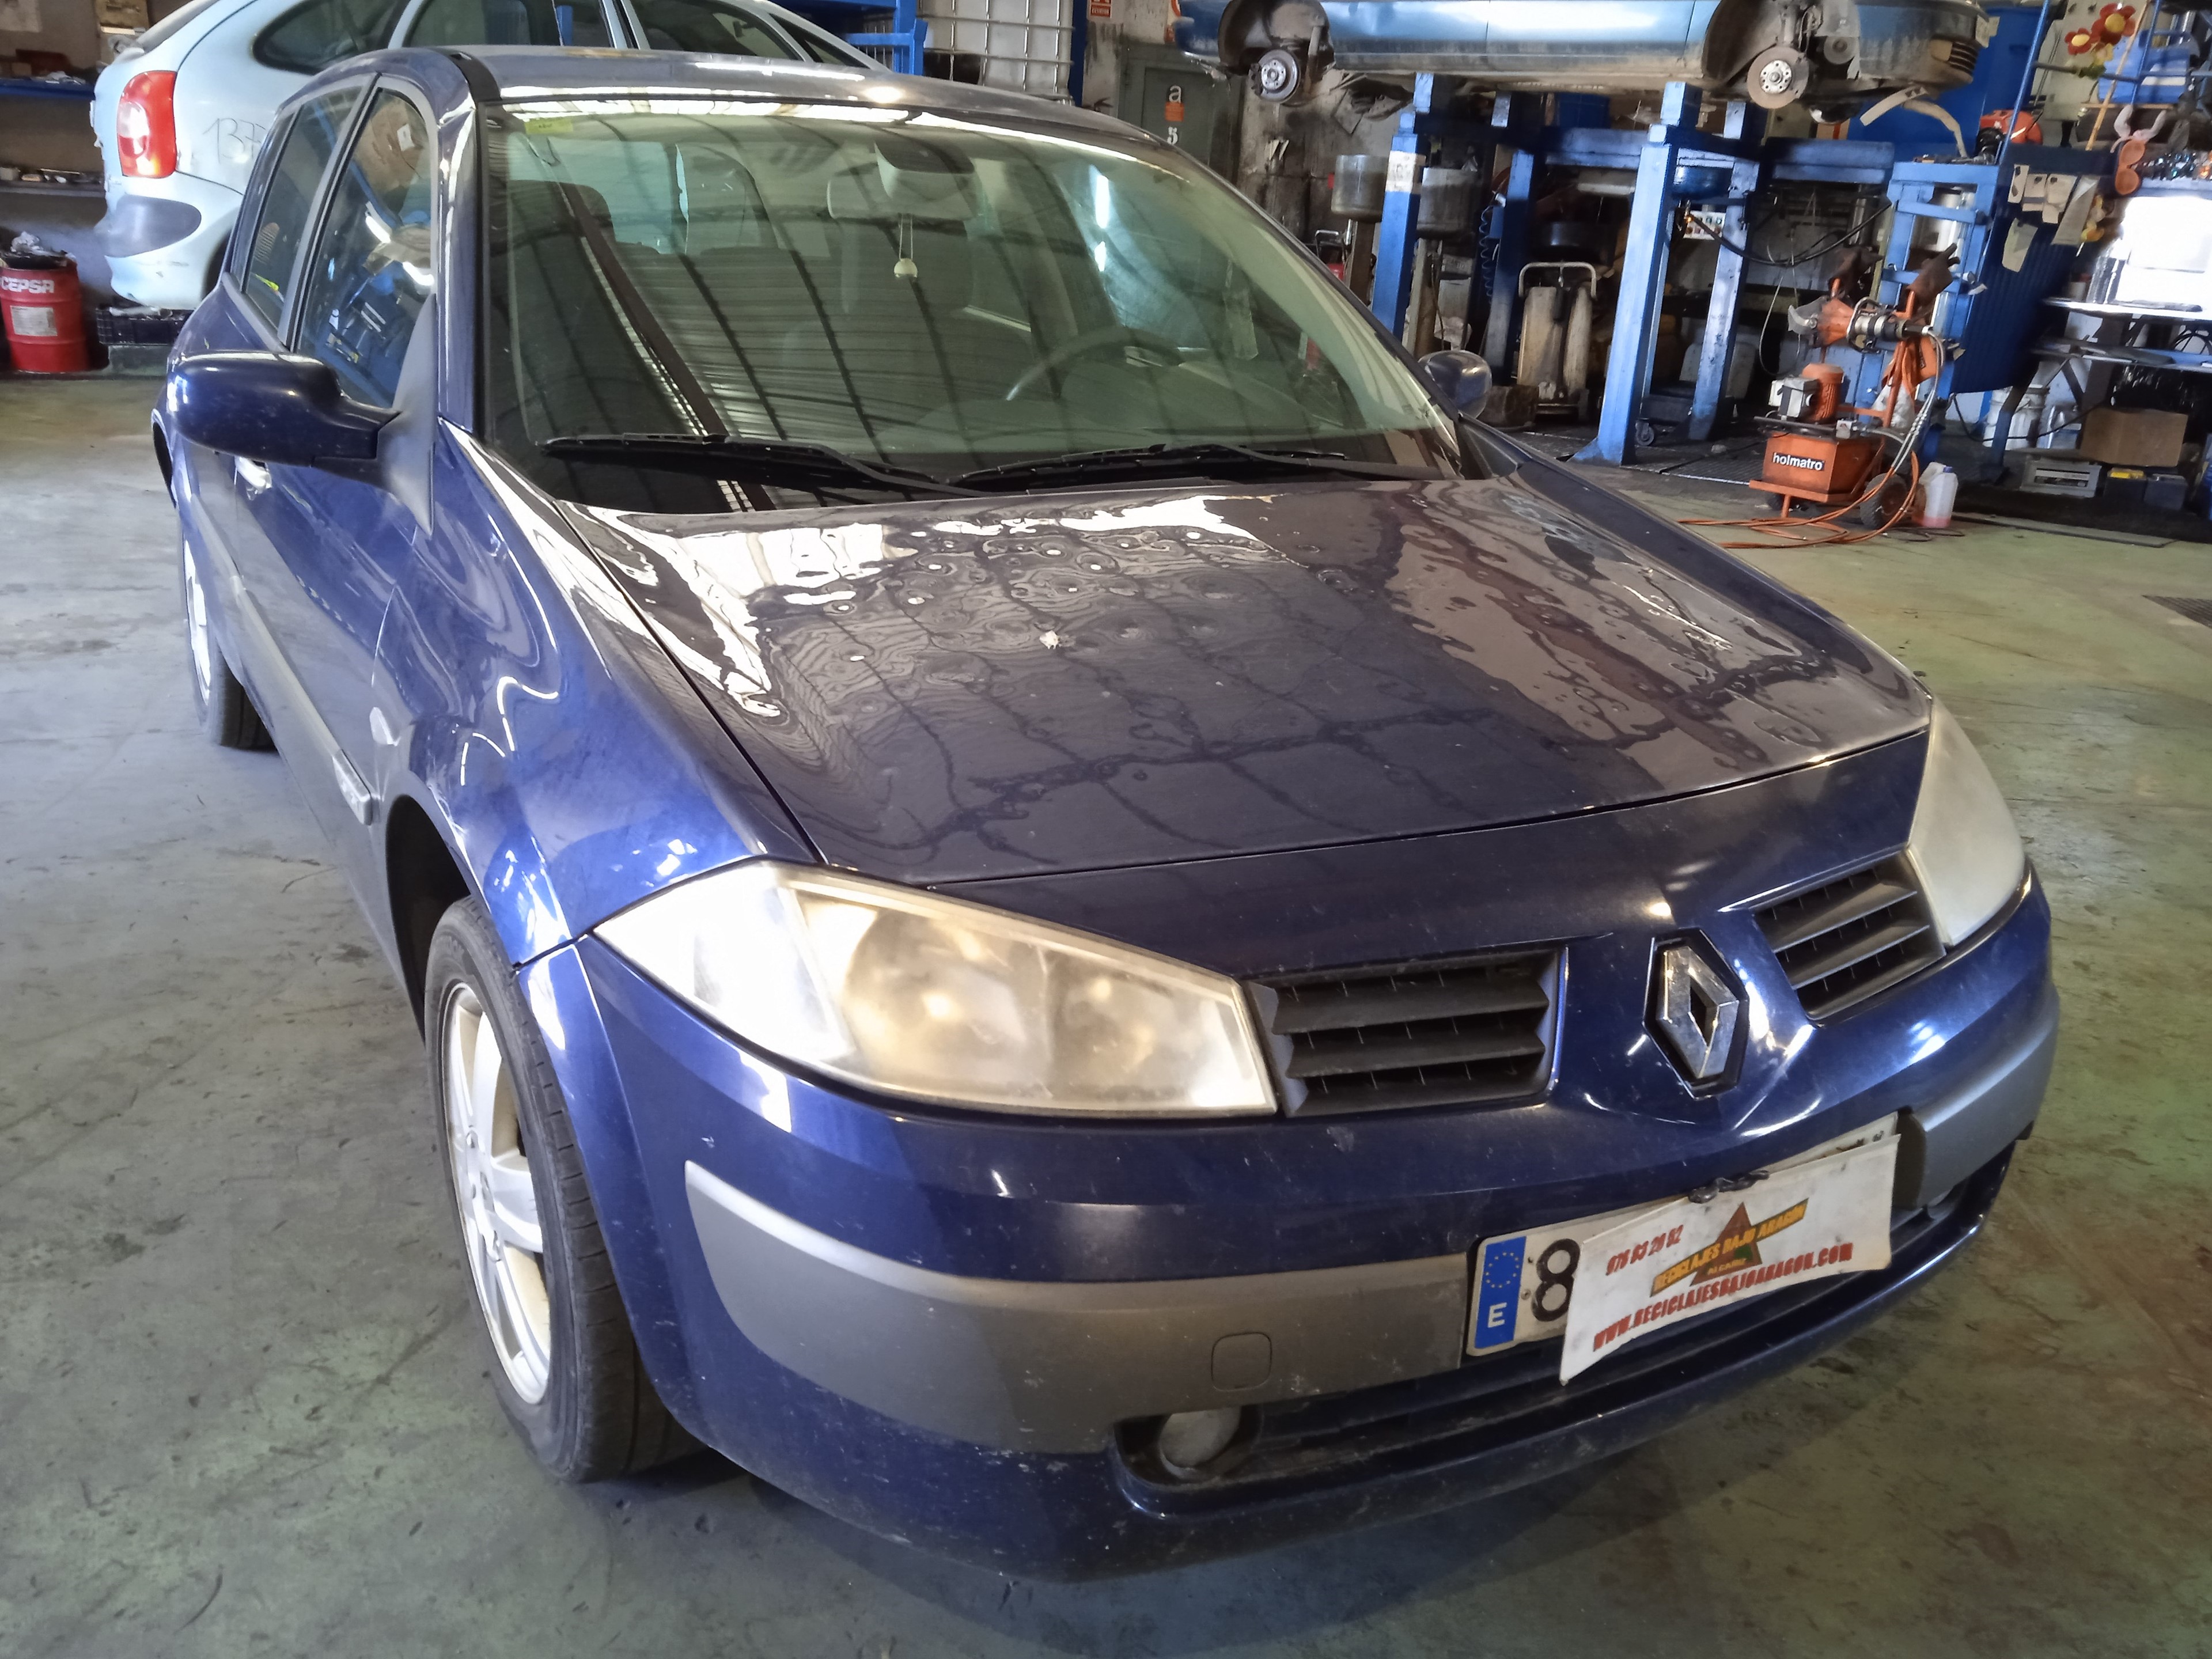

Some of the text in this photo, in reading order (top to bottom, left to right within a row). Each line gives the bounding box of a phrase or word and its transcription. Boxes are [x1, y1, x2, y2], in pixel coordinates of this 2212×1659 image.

[1, 276, 55, 294] CEPSA
[1772, 452, 1823, 471] holmatro
[1531, 1238, 1580, 1322] 8
[1487, 1302, 1508, 1328] E
